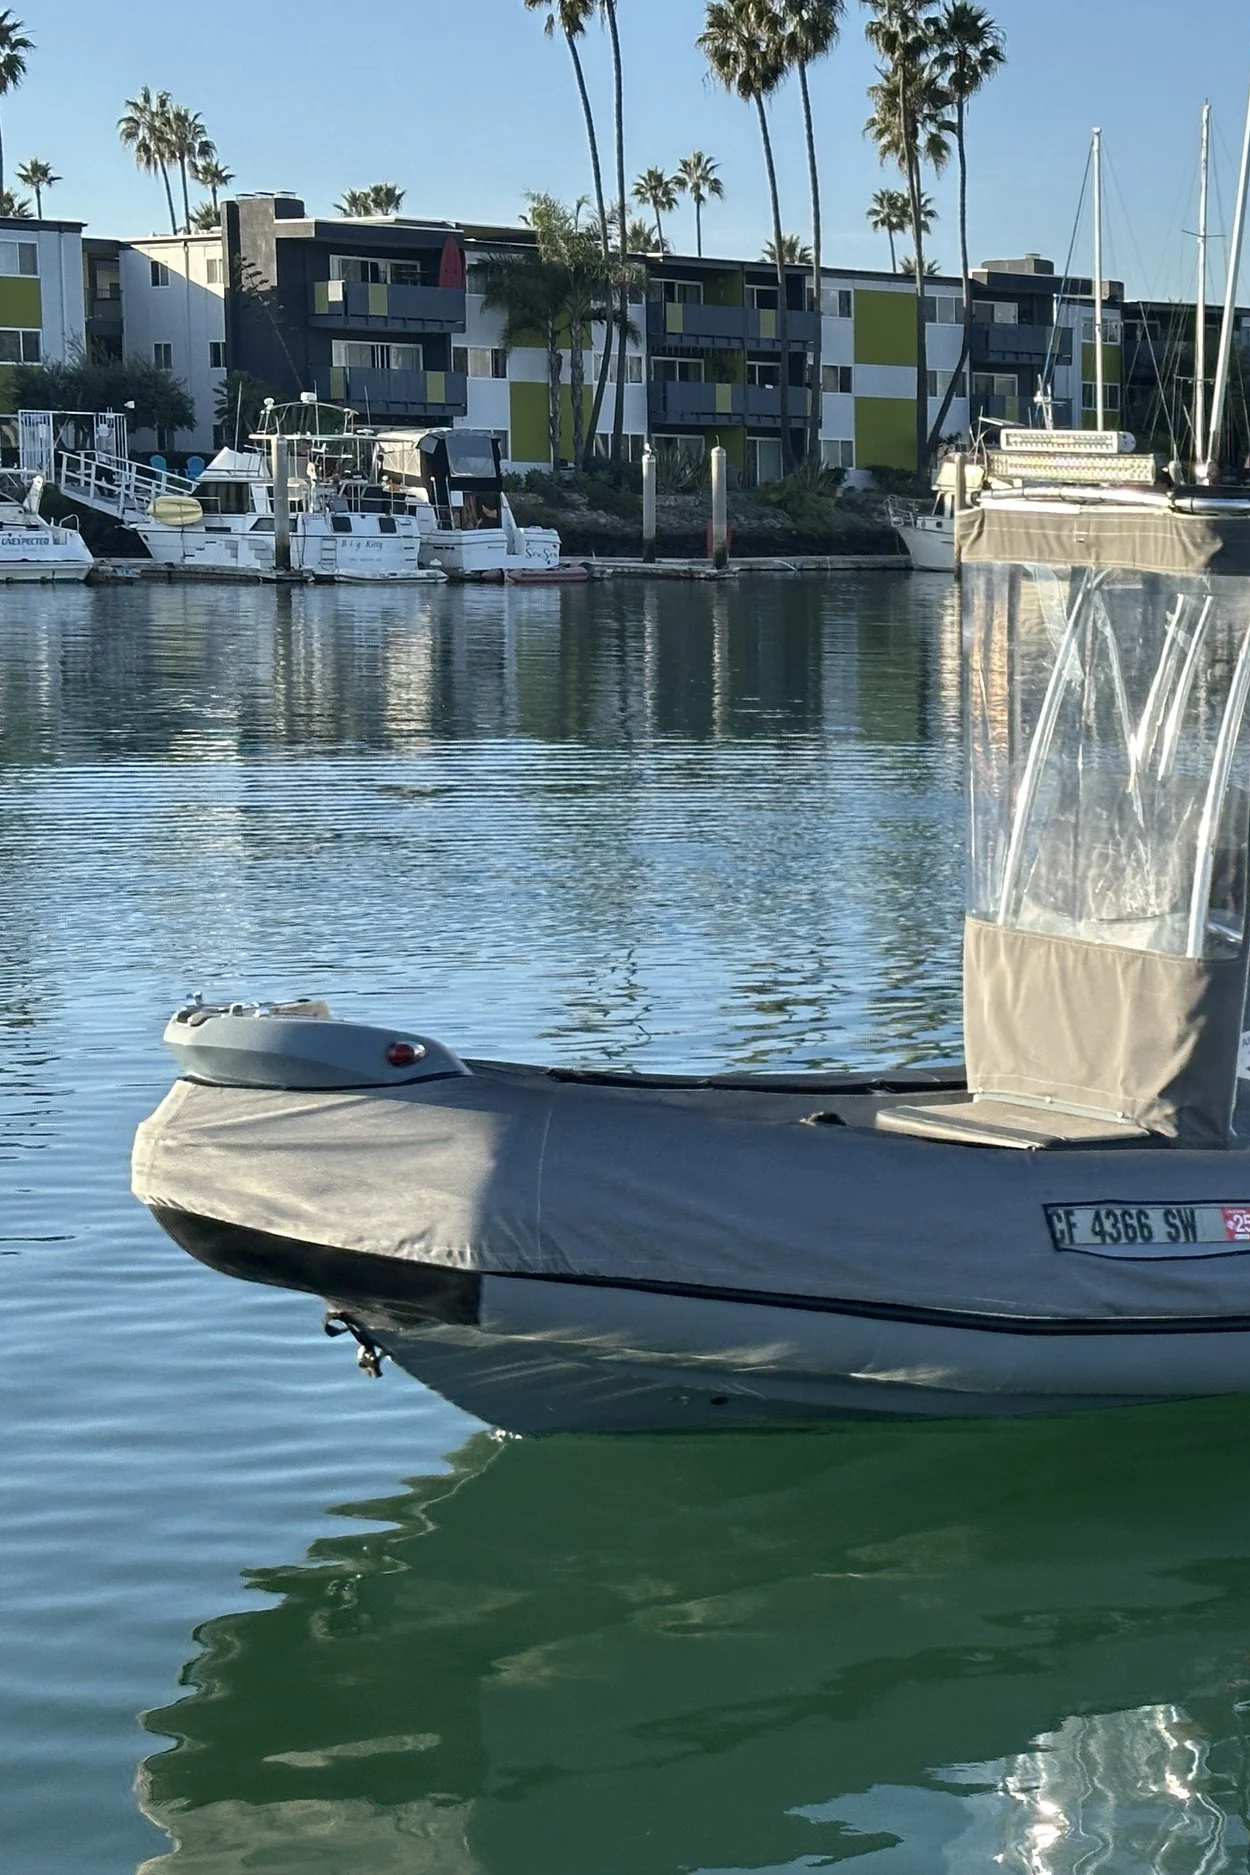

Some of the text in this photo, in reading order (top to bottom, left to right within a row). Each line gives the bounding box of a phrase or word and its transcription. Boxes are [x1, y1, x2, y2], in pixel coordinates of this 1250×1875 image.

[1, 537, 50, 546] UNEXPECTED
[1091, 1207, 1154, 1244] 4366
[1163, 1206, 1198, 1243] SW
